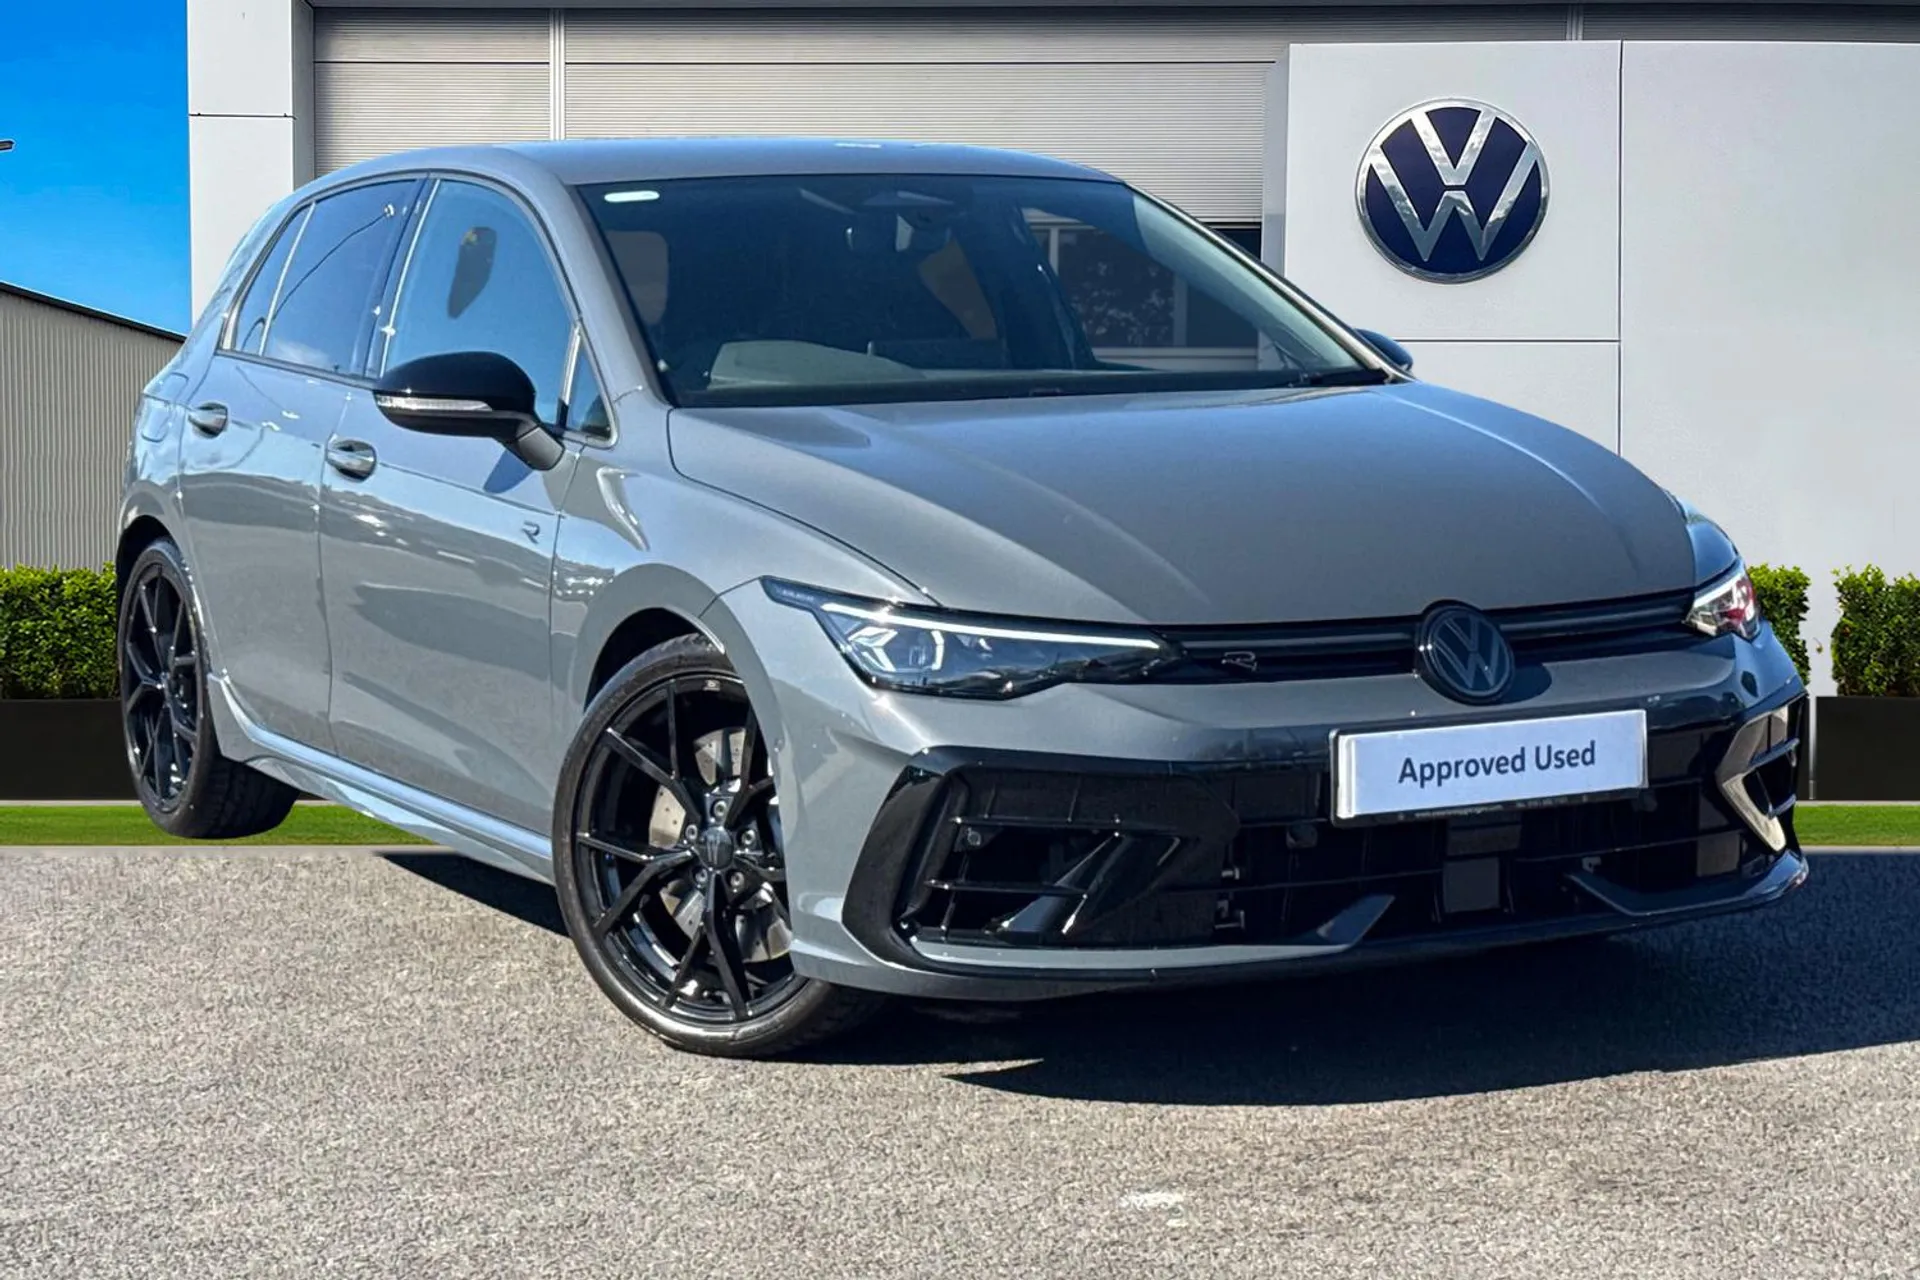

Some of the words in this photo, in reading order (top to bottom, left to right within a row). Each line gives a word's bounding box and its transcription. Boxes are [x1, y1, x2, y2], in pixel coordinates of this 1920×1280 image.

[1362, 105, 1543, 264] VW
[521, 521, 540, 544] R
[1432, 611, 1502, 691] VW
[1398, 746, 1526, 788] Approved
[1535, 739, 1596, 771] Used
